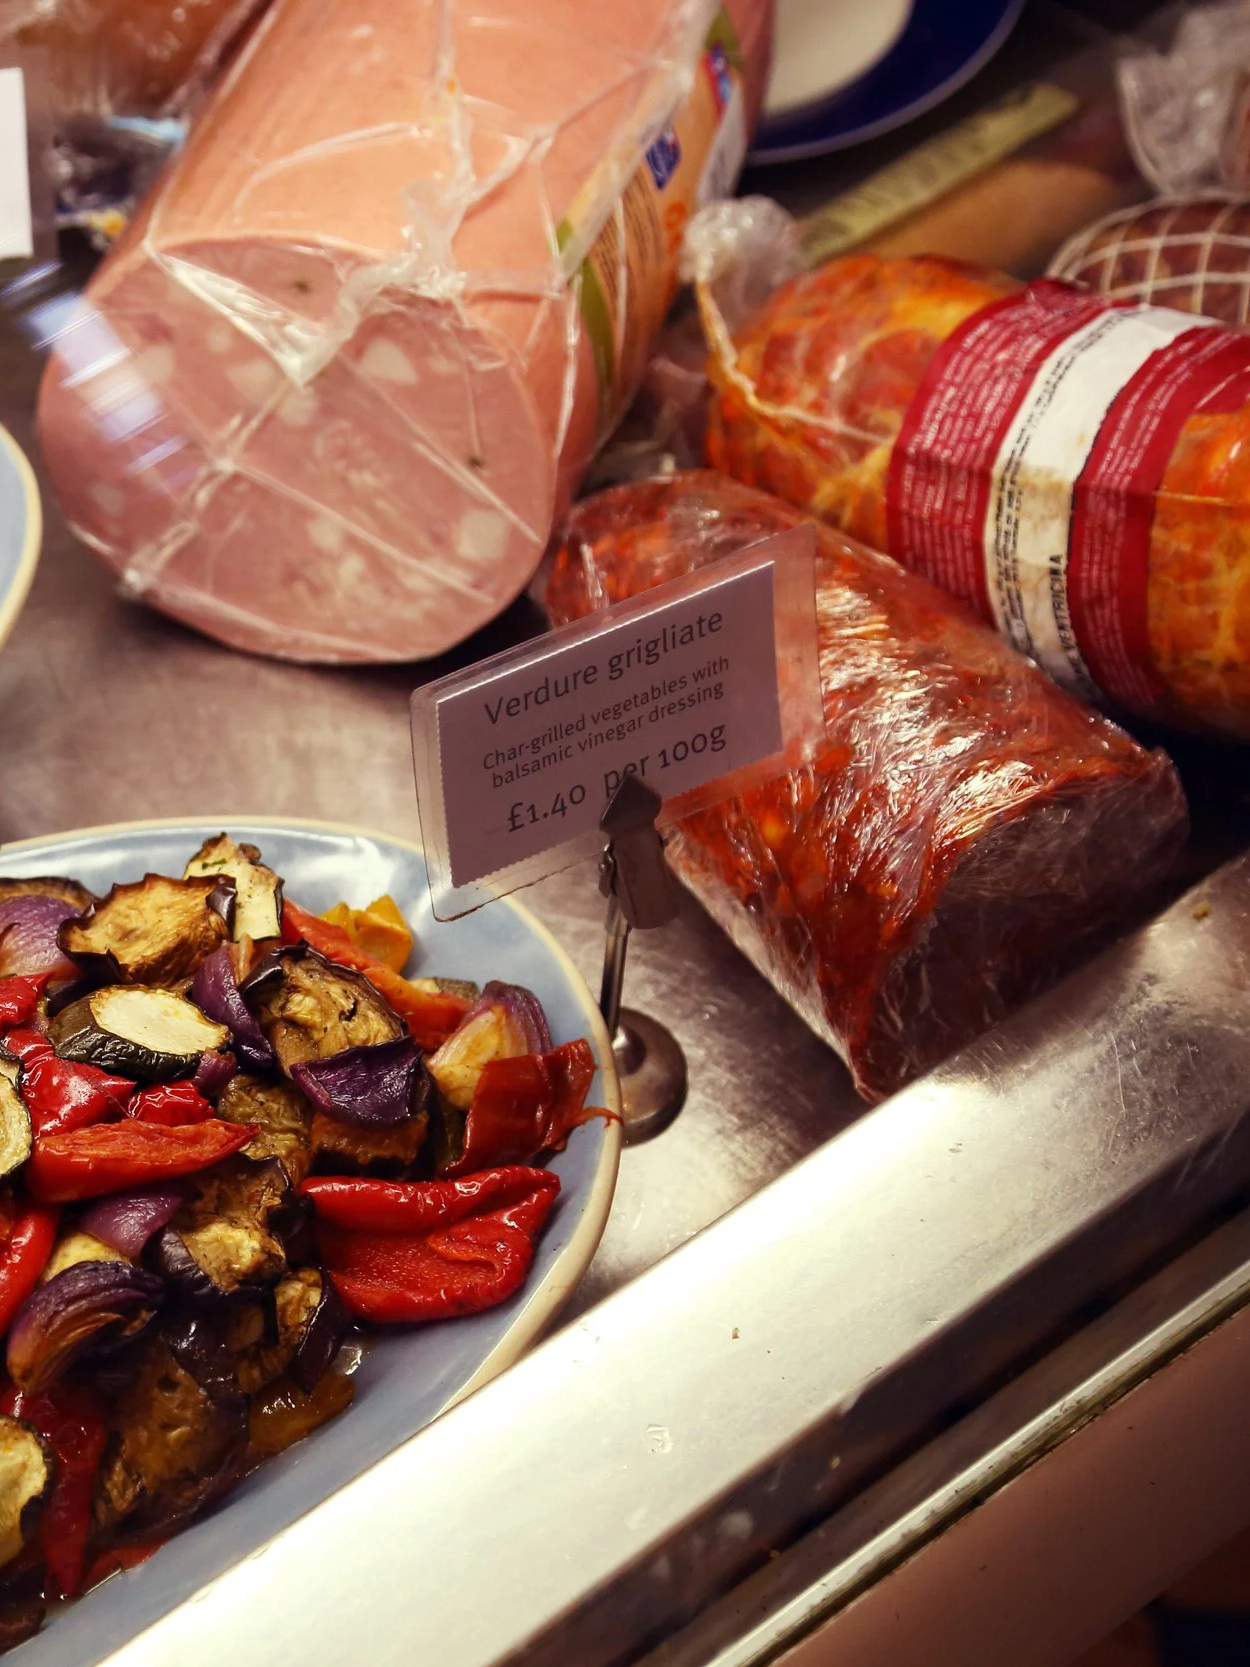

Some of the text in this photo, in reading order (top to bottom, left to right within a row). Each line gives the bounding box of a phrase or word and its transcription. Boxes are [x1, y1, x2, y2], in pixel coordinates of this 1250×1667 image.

[483, 611, 723, 727] Verdure grigliate
[483, 655, 730, 771] Char-grilled vegetables with
[492, 681, 725, 790] balsamic vinegar dressing
[508, 723, 727, 833] £1.40 per 100g
